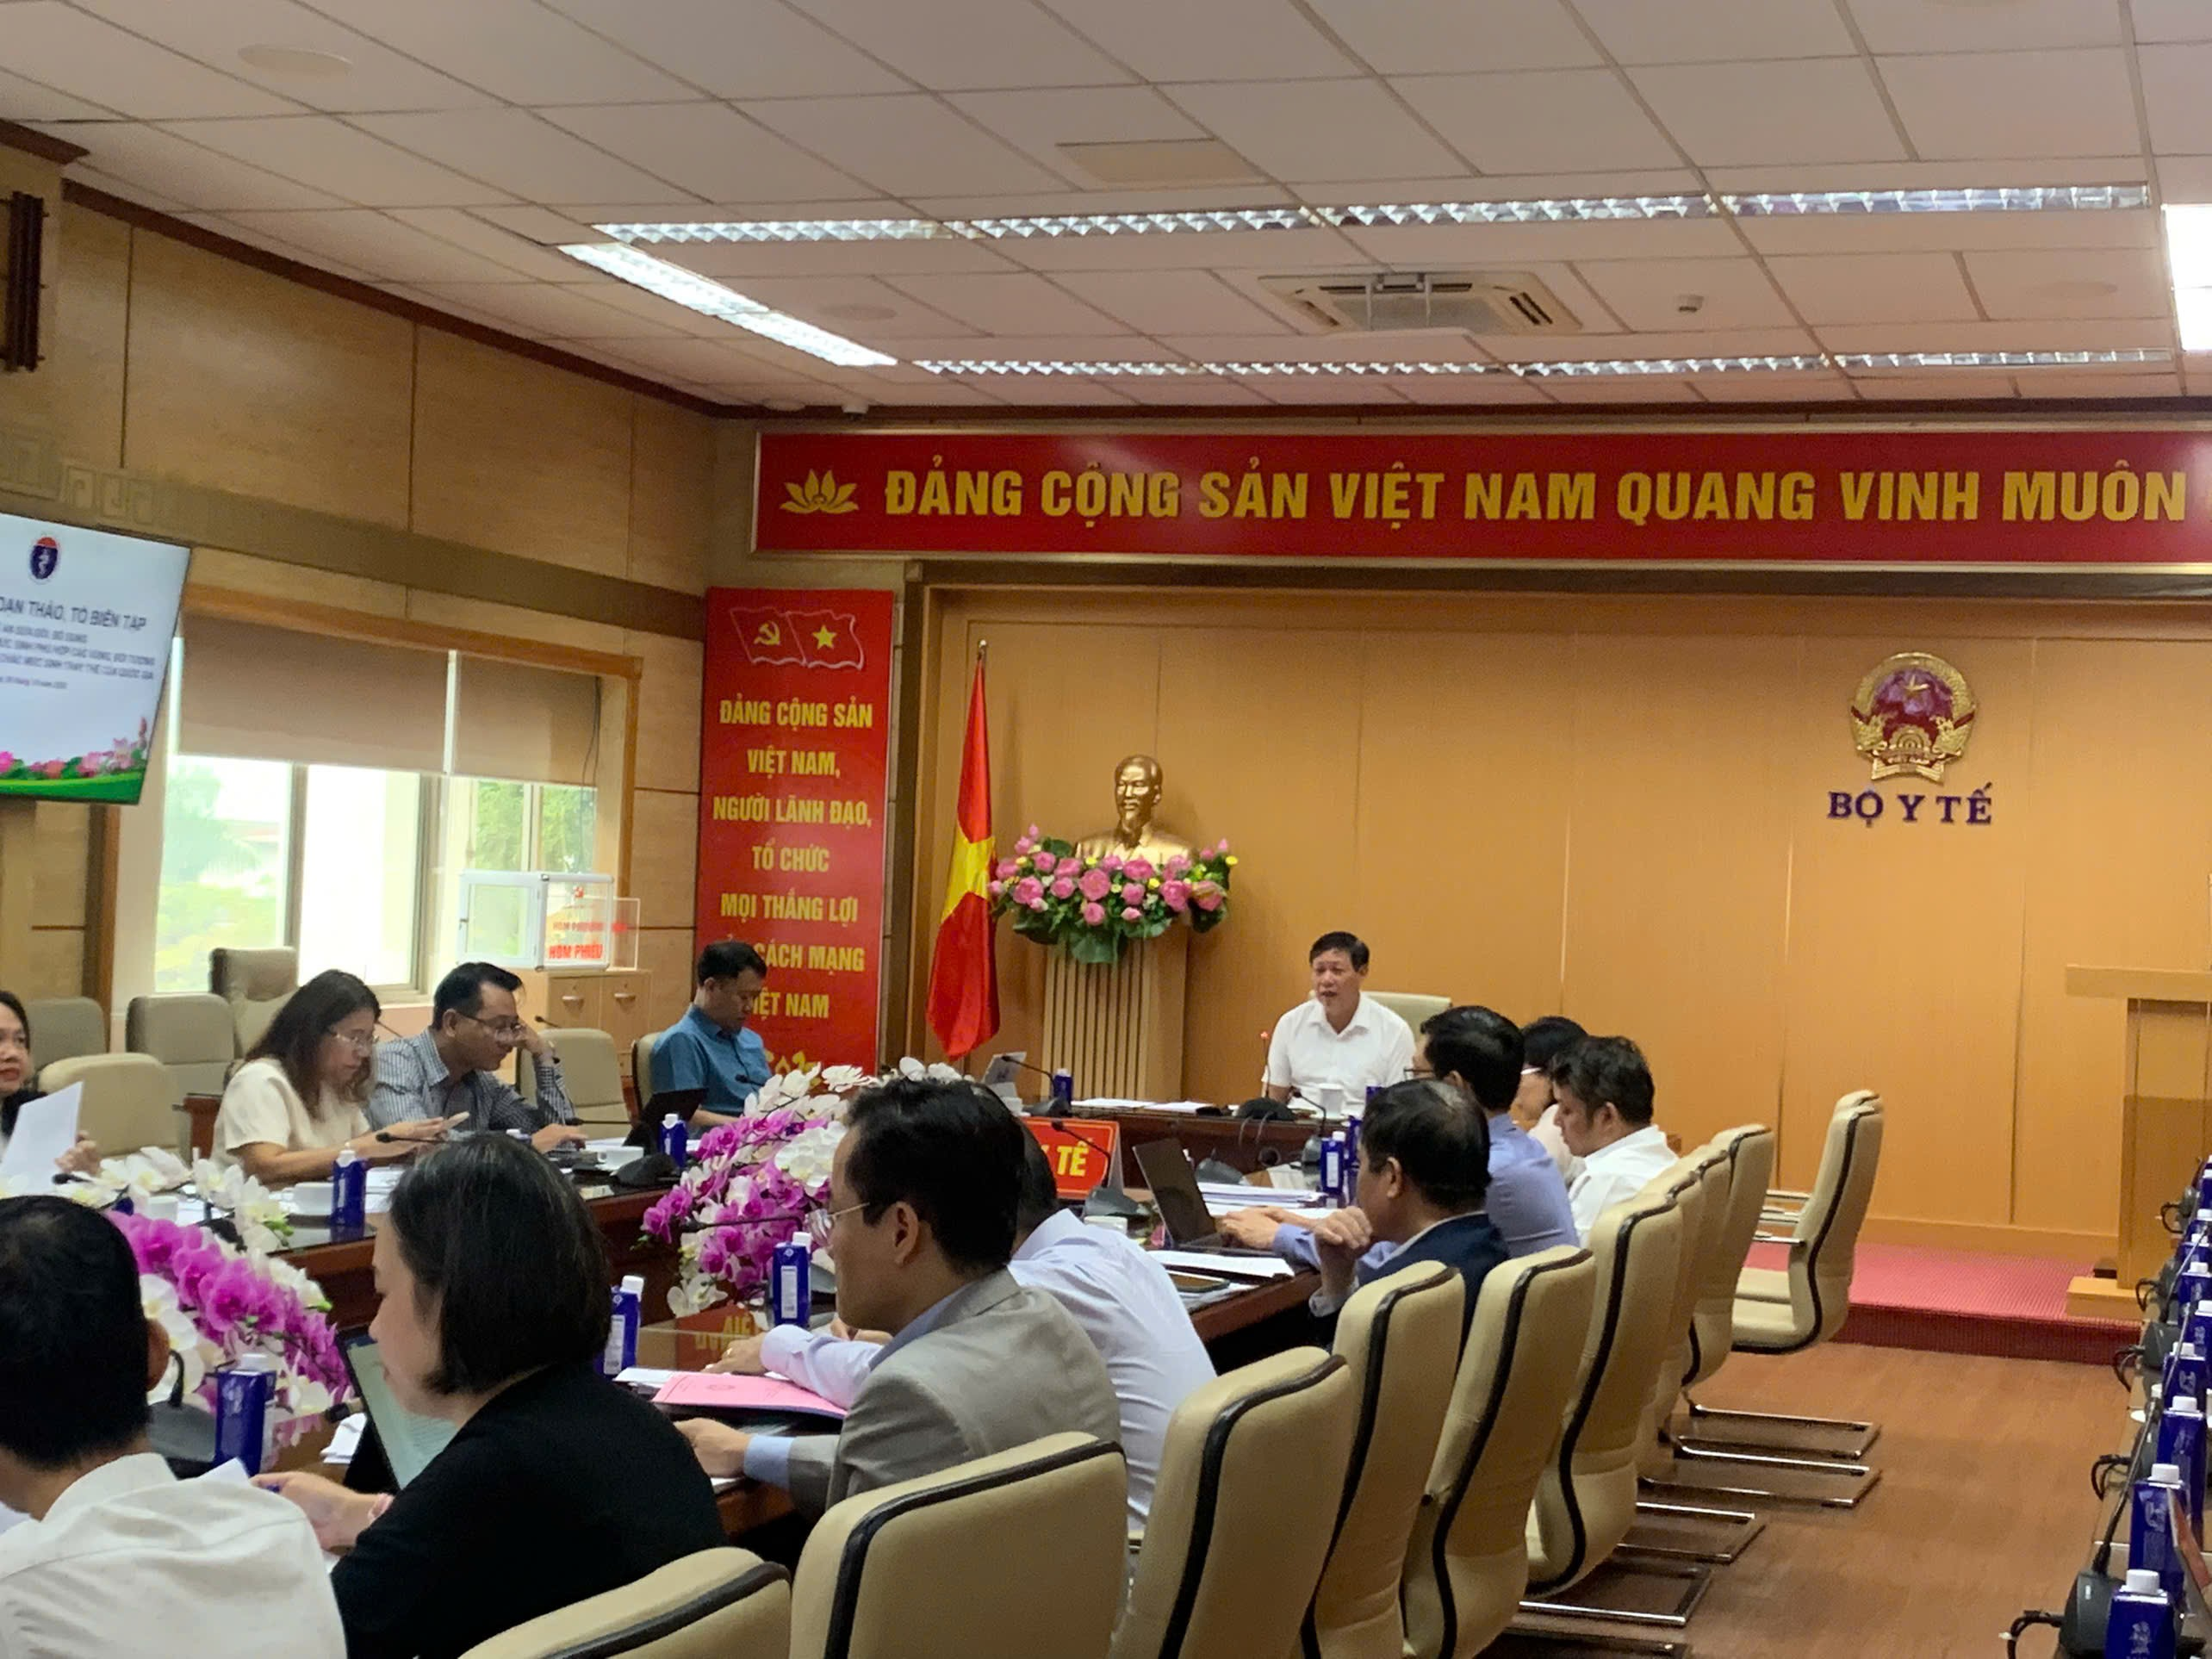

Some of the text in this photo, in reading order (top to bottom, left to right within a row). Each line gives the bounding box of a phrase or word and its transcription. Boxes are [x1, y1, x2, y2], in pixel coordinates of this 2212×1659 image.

[885, 455, 2186, 530] ĐẢNG CỘNG SẢN VIỆT NAM QUANG VINH MUÔN
[719, 693, 873, 731] ĐẢNG CỘNG SẢN
[747, 744, 841, 779] VIỆT NAM,
[712, 792, 873, 830] NGƯỜI LÃNH ĐẠO,
[1827, 781, 1993, 828] BỘ Y TẾ
[752, 837, 830, 873] TỔ CHỨC
[720, 887, 859, 928] MỌI THẮNG LỢI
[808, 946, 865, 975] MẠNG
[750, 986, 830, 1021] IỆT NAM
